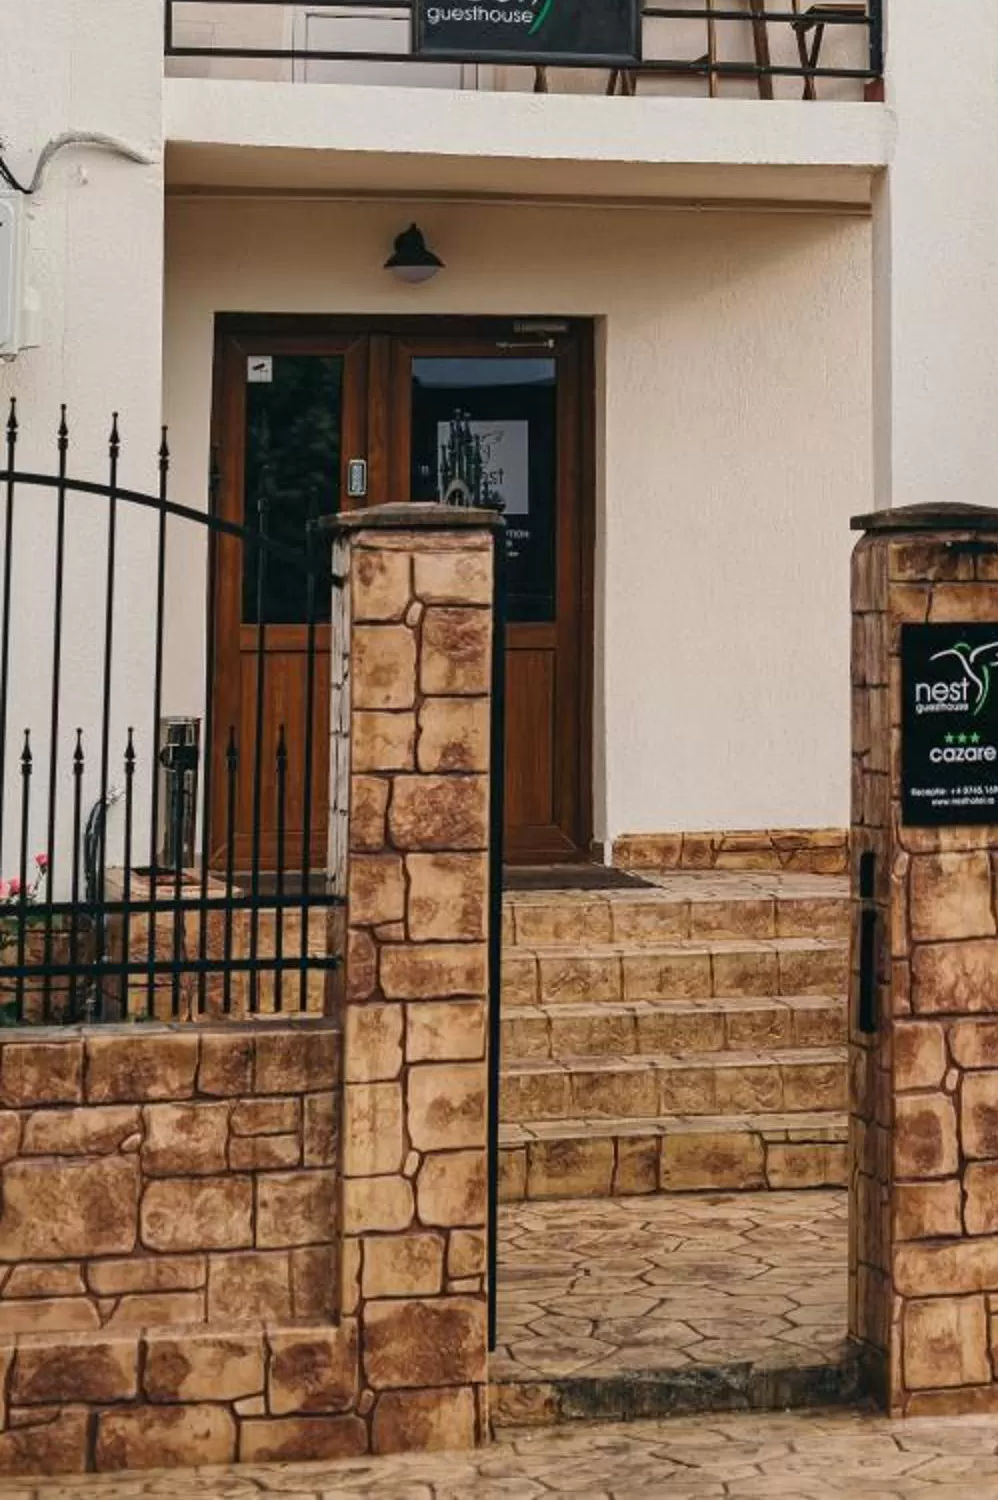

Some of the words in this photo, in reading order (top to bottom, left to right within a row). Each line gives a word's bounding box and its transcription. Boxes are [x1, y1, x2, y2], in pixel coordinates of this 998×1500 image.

[426, 6, 533, 25] guesthouse
[915, 676, 970, 702] nest
[929, 746, 997, 762] cazare
